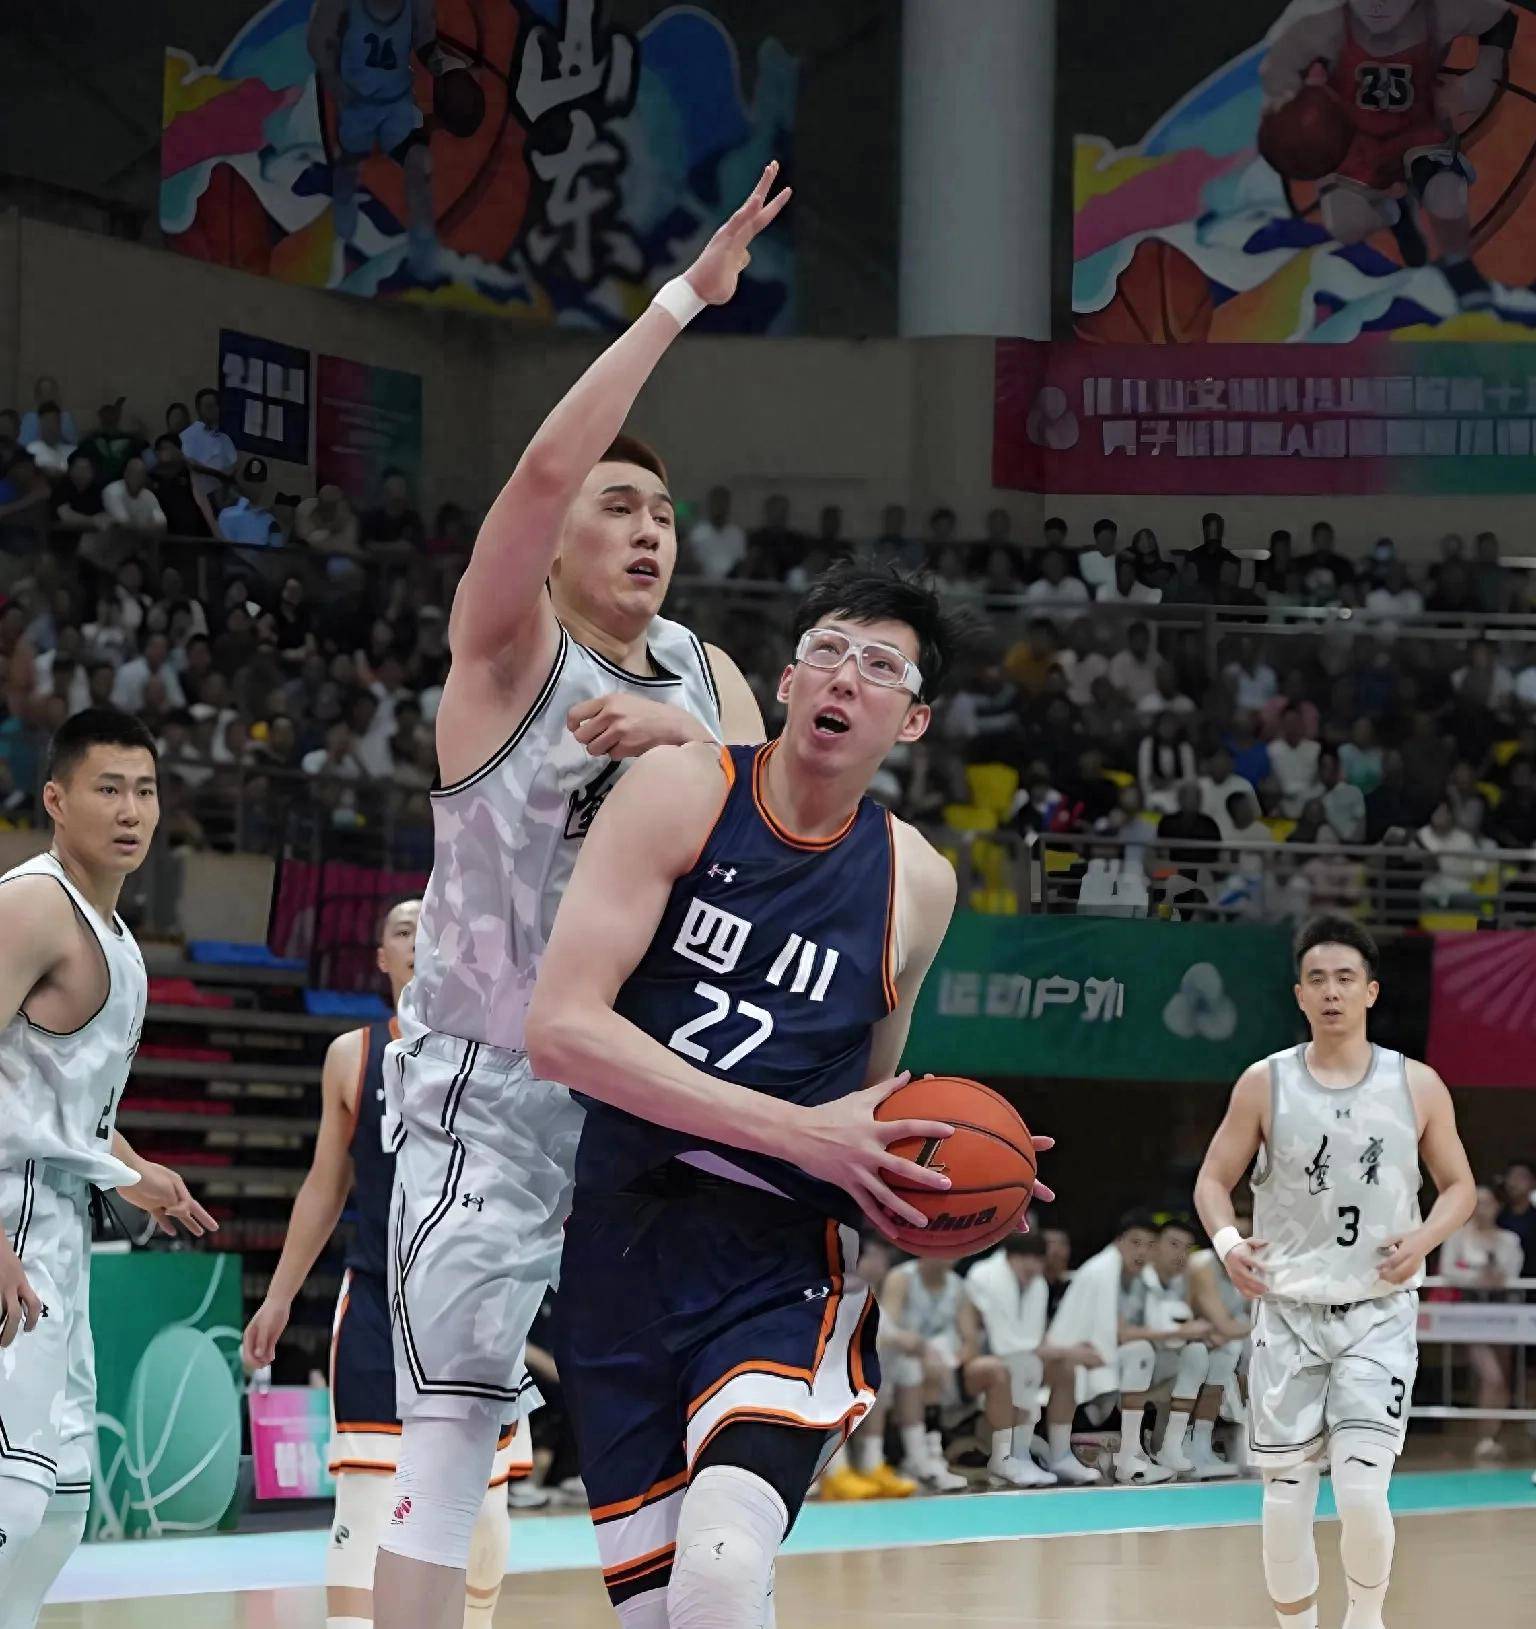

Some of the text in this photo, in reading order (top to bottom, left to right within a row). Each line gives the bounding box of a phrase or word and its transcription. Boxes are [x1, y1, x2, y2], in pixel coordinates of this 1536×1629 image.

[672, 896, 839, 1002] 四川
[668, 980, 774, 1071] 27
[1336, 1205, 1360, 1247] 3
[1386, 1376, 1406, 1419] 3
